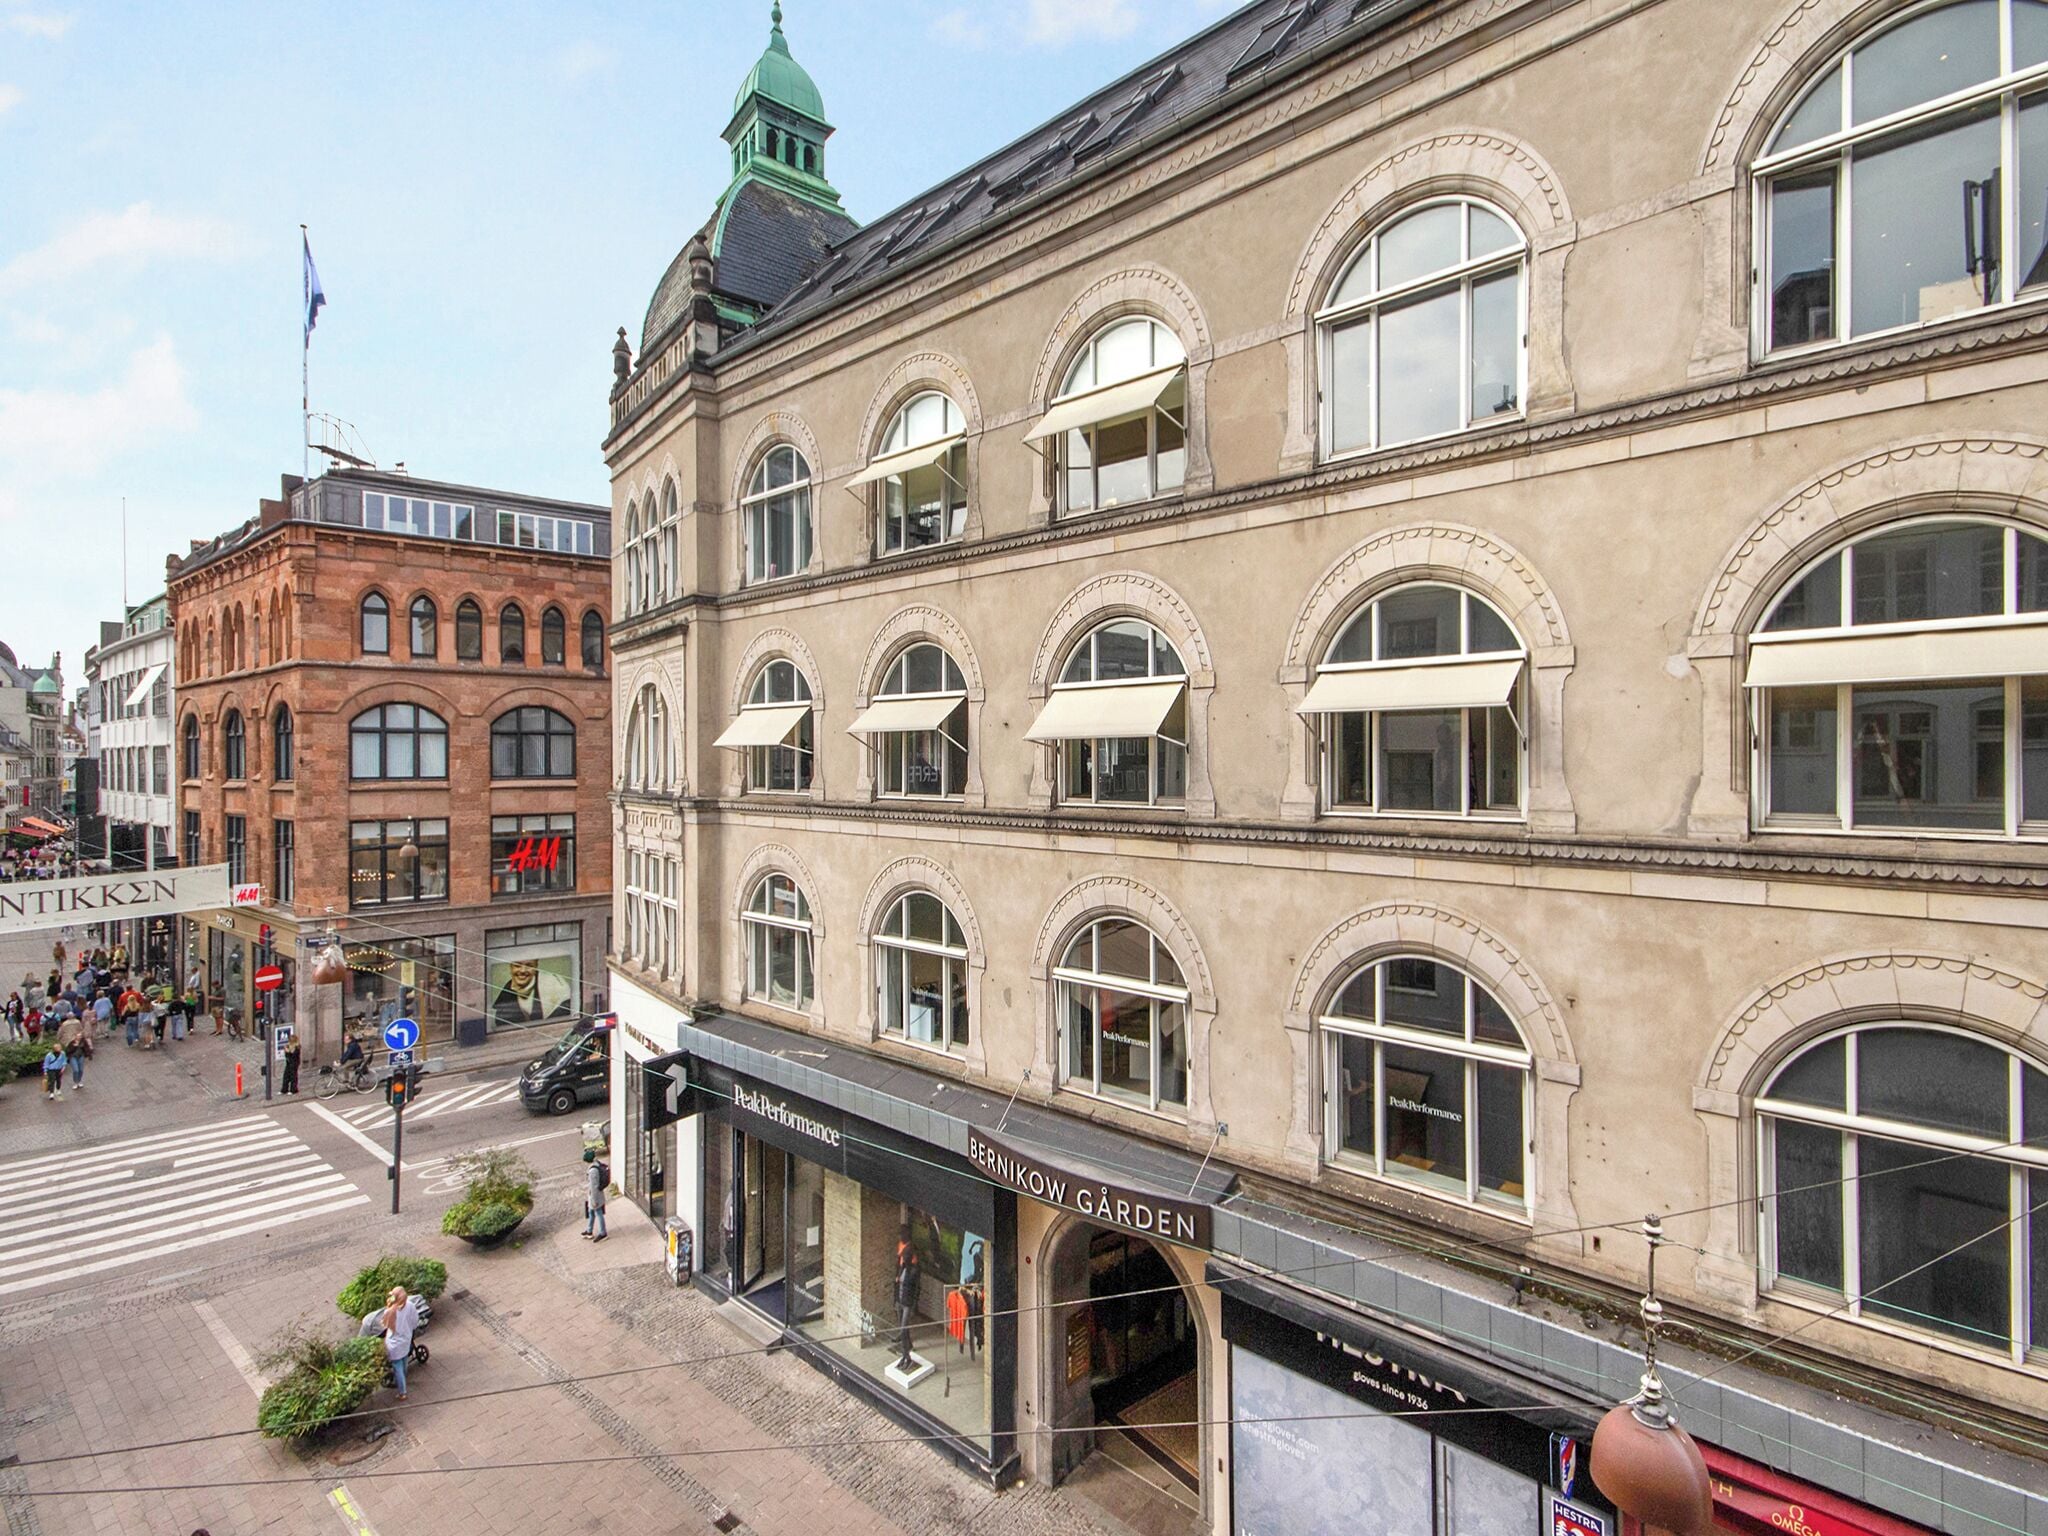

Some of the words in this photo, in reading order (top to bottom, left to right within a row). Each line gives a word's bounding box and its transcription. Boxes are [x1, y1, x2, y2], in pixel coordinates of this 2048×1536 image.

[508, 835, 560, 873] H&M
[236, 886, 259, 902] H&M
[734, 1083, 840, 1147] PeakPerformance
[1389, 1095, 1462, 1122] PeakPerformance
[970, 1136, 1067, 1204] BERNIKOW
[1076, 1186, 1195, 1240] GÅRDEN
[1353, 1370, 1380, 1389] gloves
[1381, 1382, 1405, 1400] since
[1407, 1392, 1429, 1410] 1936
[1555, 1503, 1600, 1533] HESTRA
